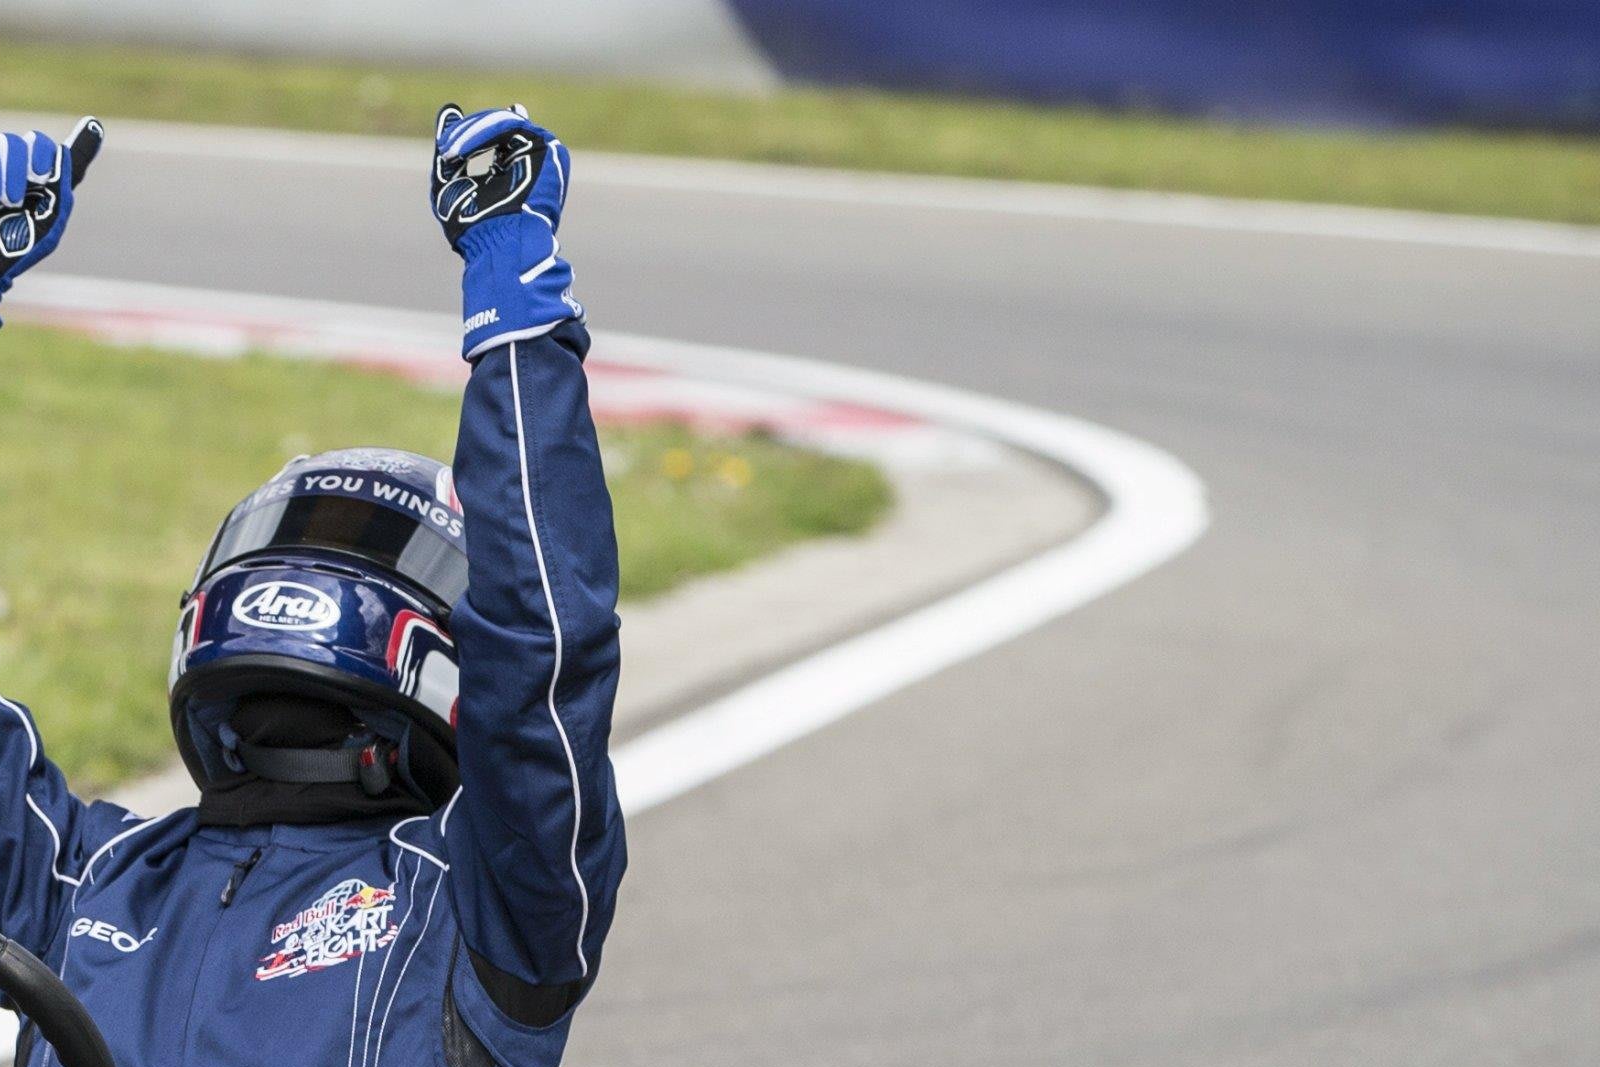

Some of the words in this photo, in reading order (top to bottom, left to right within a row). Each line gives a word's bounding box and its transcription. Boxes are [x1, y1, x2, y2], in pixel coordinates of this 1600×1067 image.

[304, 474, 364, 493] YOU
[373, 480, 464, 538] WINGS
[241, 585, 330, 620] Arai
[270, 912, 302, 942] Red
[304, 902, 336, 924] Bull
[324, 905, 394, 937] KART
[305, 929, 381, 966] FIGHT
